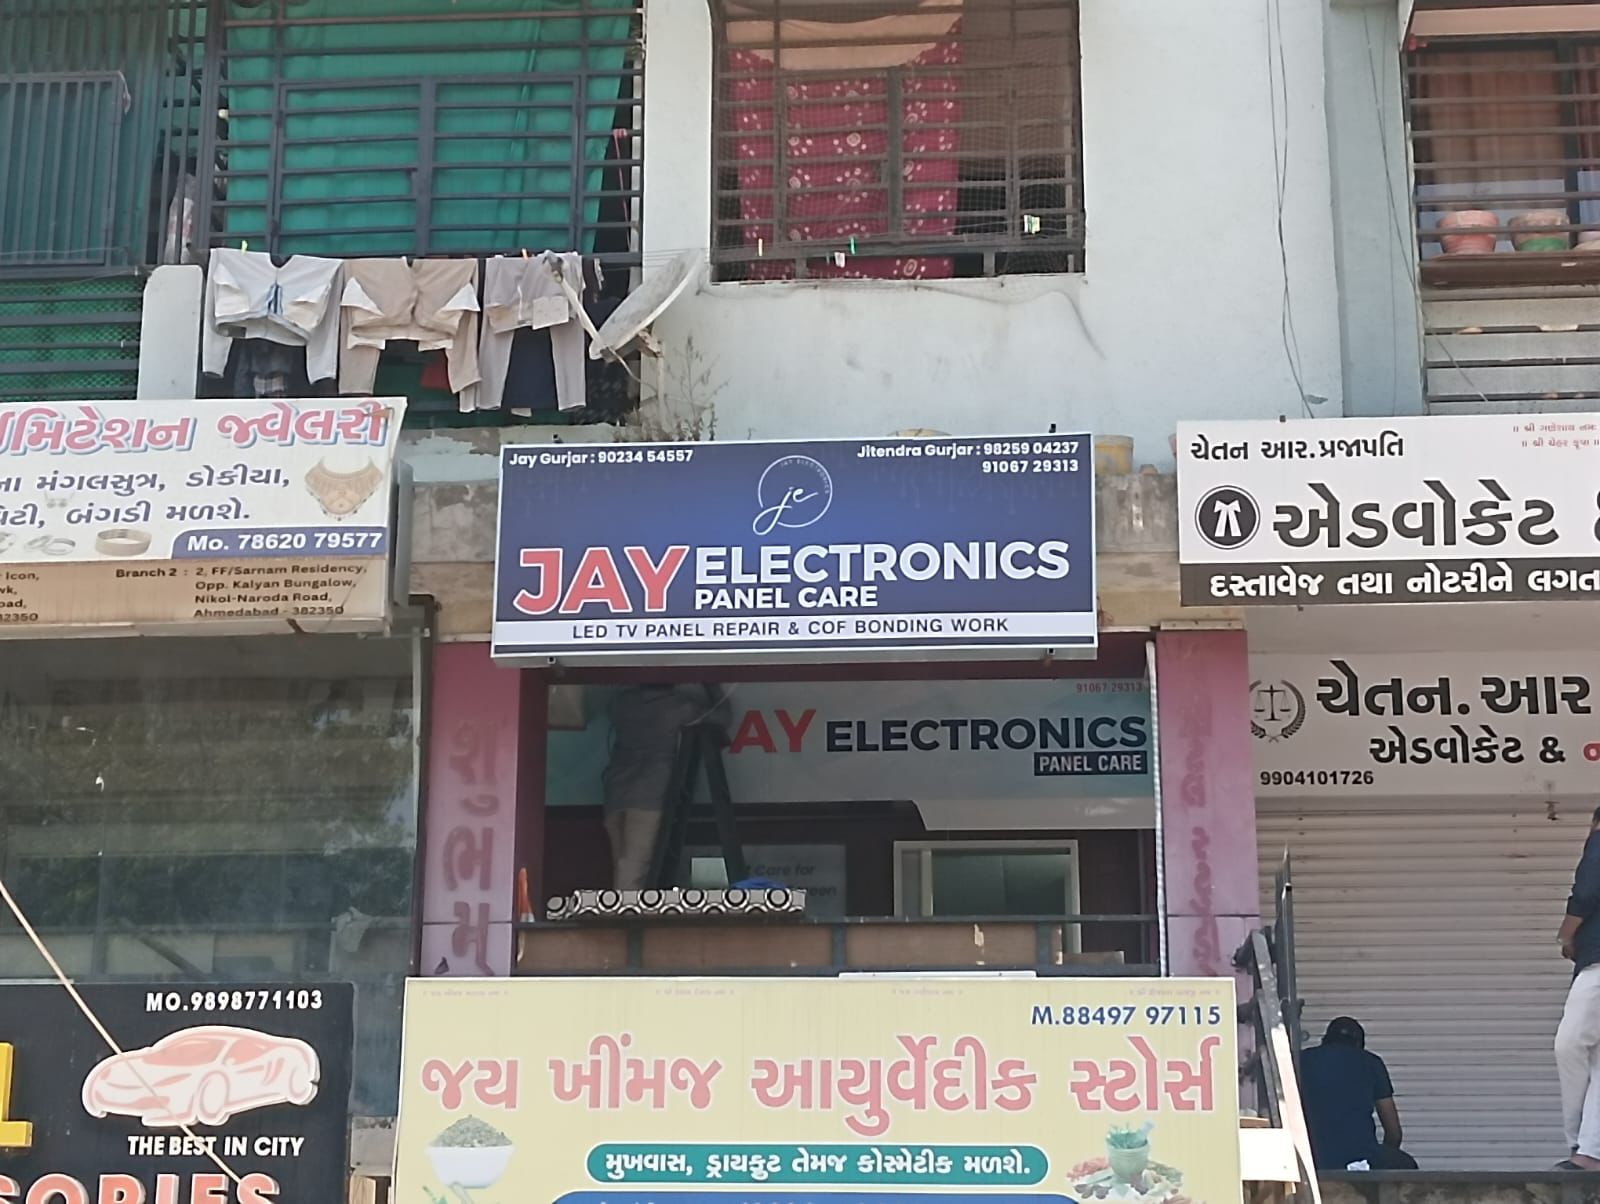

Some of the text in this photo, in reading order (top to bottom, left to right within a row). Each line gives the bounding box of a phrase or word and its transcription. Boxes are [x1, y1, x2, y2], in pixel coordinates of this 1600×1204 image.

[857, 444, 922, 458] Jitendra
[924, 443, 973, 460] Gurjar
[984, 443, 1030, 455] 98259
[1032, 442, 1079, 454] 04237
[1191, 434, 1249, 460] ચેતન
[509, 453, 536, 468] Jay
[540, 451, 588, 467] Gurjar
[598, 451, 643, 462] 90234
[647, 450, 693, 461] 54557
[982, 460, 1079, 473] 91067 29313
[186, 465, 290, 489] ડોકીયા,
[66, 500, 151, 524] બંગડી
[166, 497, 250, 522] મળશે.
[1273, 479, 1559, 548] એડવોકેટ
[188, 532, 383, 551] Mo. 78620 79577
[116, 569, 166, 579] Branch
[168, 569, 177, 577] 2
[195, 568, 208, 577] 2,
[211, 566, 287, 576] FF/Sarnam
[291, 563, 367, 575] Residency,
[513, 541, 1070, 615] JAY ELECTRONICS
[1210, 565, 1325, 598] દસ્તાવેજ
[1336, 572, 1393, 596] તથા
[1406, 562, 1513, 594] નોટરીને
[195, 579, 357, 592] Opp. Kalyan Bungalow,
[195, 592, 332, 604] Nikol-Naroda Road,
[695, 586, 878, 609] PANEL CARE
[194, 606, 278, 617] Ahmedabad
[293, 604, 344, 615] 382350
[573, 617, 1009, 638] LED TV PANEL REPAIR & COF BONDING WORK
[1076, 682, 1143, 693] 91067 29313
[826, 716, 1147, 753] ELECTRONICS
[1369, 725, 1525, 764] એડવોકેટ
[1539, 736, 1566, 763] &
[1039, 754, 1142, 771] PANEL CARE
[1260, 770, 1374, 785] 9904101726
[1146, 1005, 1221, 1024] 97115
[422, 1059, 519, 1110] જય
[1070, 1036, 1220, 1111] સ્ટોર્સ
[128, 1136, 304, 1156] THE BEST IN CITY
[605, 1153, 693, 1180] મુખવાસ,
[791, 1147, 848, 1173] તેમજ
[964, 1148, 1031, 1174] મળશે.
